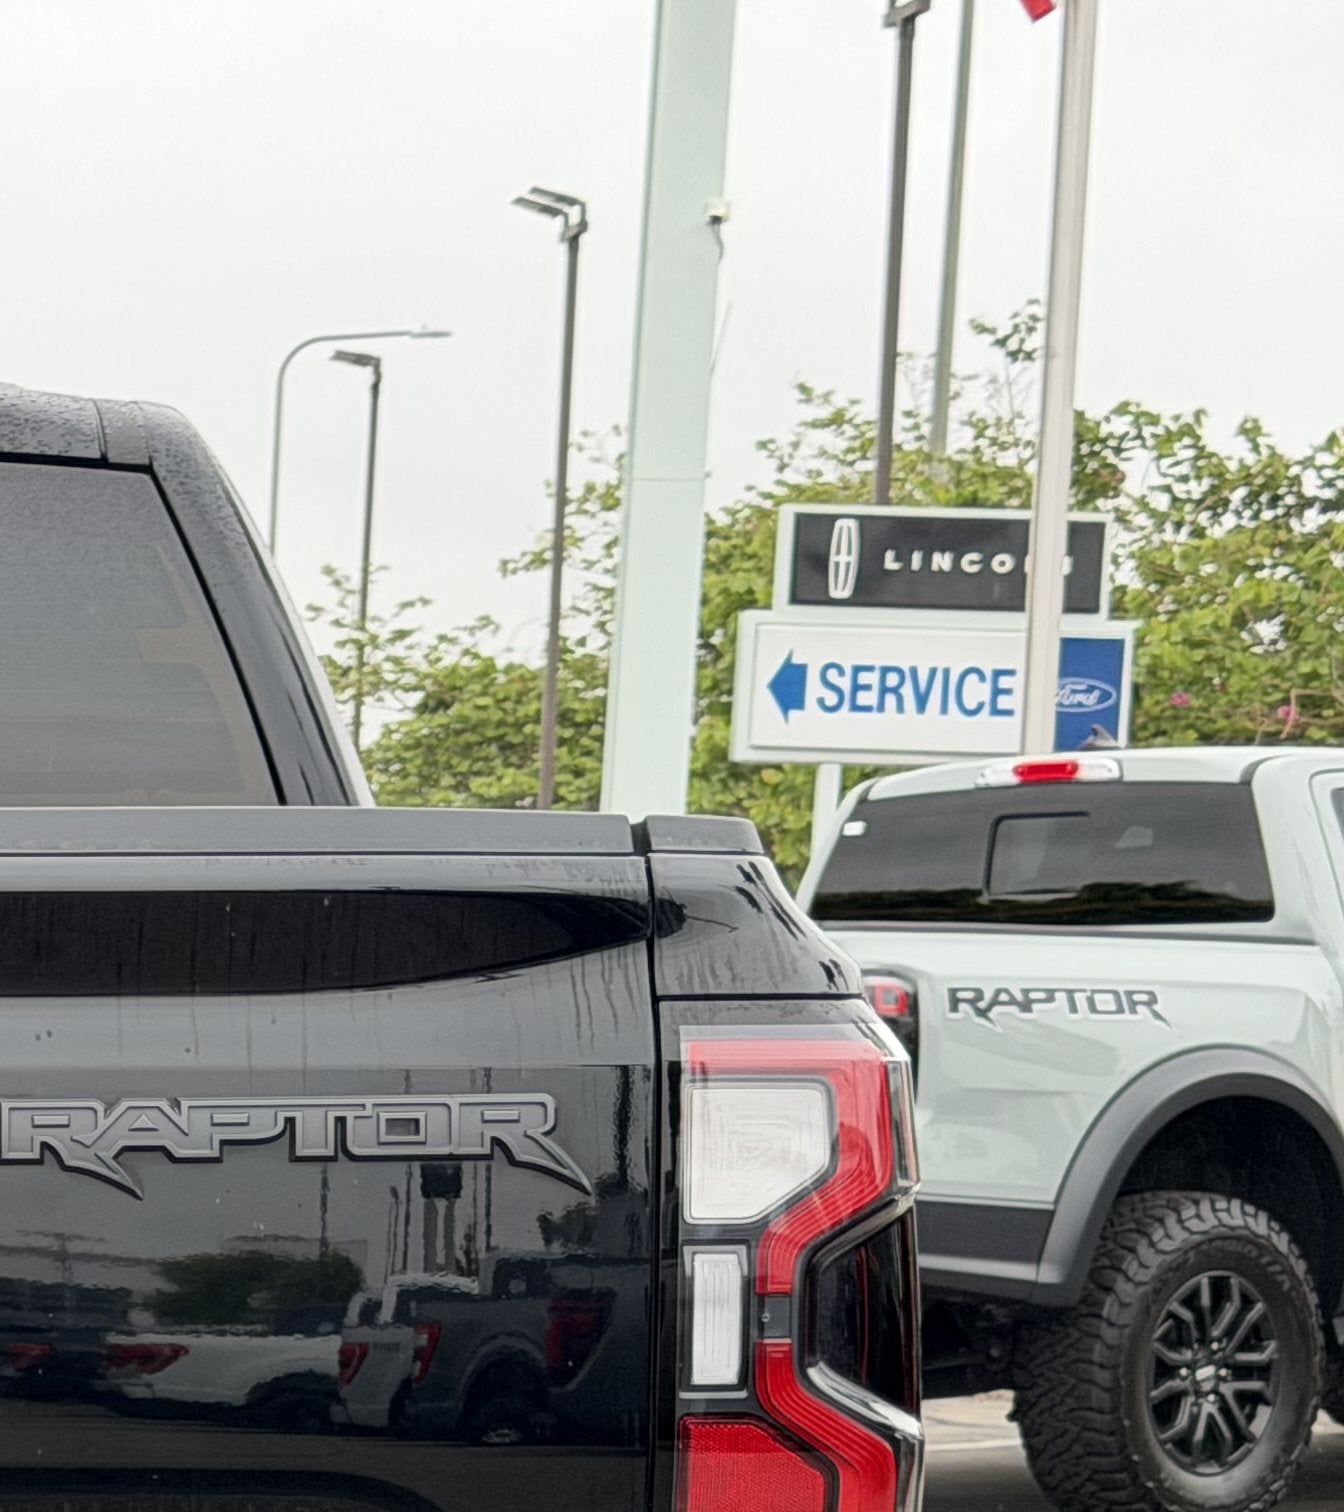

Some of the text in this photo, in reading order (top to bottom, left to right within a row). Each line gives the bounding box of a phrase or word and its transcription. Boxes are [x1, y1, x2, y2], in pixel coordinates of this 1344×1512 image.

[883, 549, 1073, 576] LINCO
[816, 662, 1016, 717] SERVICE
[947, 986, 1177, 1032] RAPTOR
